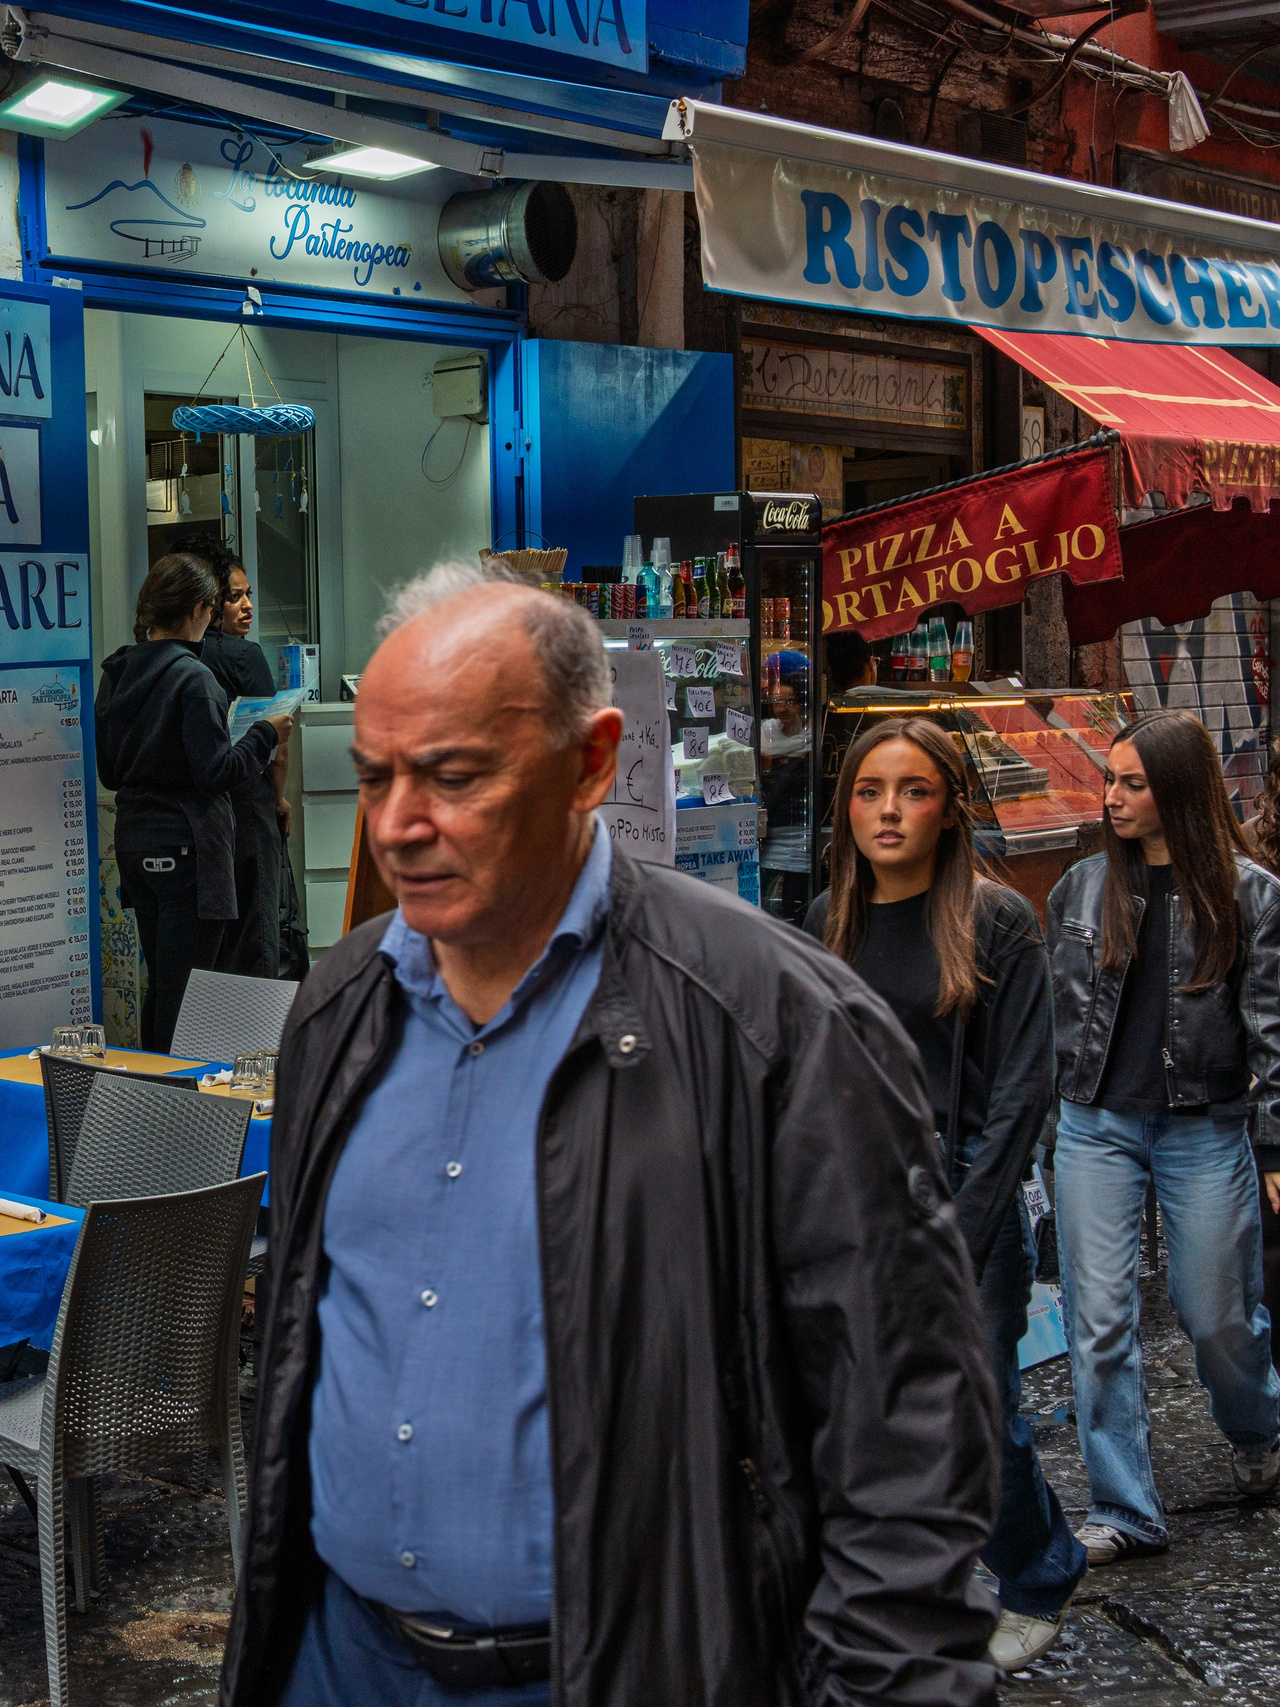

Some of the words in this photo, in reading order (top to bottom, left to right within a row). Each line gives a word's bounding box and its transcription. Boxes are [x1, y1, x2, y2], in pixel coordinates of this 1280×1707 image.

[213, 138, 256, 213] La
[264, 152, 356, 208] locanda
[270, 203, 410, 286] Partenopea
[1022, 418, 1042, 461] 68
[762, 500, 811, 531] Coca-Cola
[835, 517, 974, 584] PIZZA
[993, 502, 1028, 541] A
[719, 655, 741, 673] 10€
[693, 699, 713, 713] 10€
[731, 723, 750, 742] 10€
[688, 738, 707, 758] 8€
[67, 779, 81, 787] 15,00
[68, 789, 82, 797] 15,00
[709, 783, 730, 803] 8€
[68, 799, 82, 807] 15,00
[69, 809, 82, 818] 15,00
[69, 819, 83, 828] 15,00
[70, 837, 83, 846] 15,00
[69, 847, 84, 856] 20,00
[700, 852, 725, 867] TAKE
[727, 848, 754, 864] AWAY
